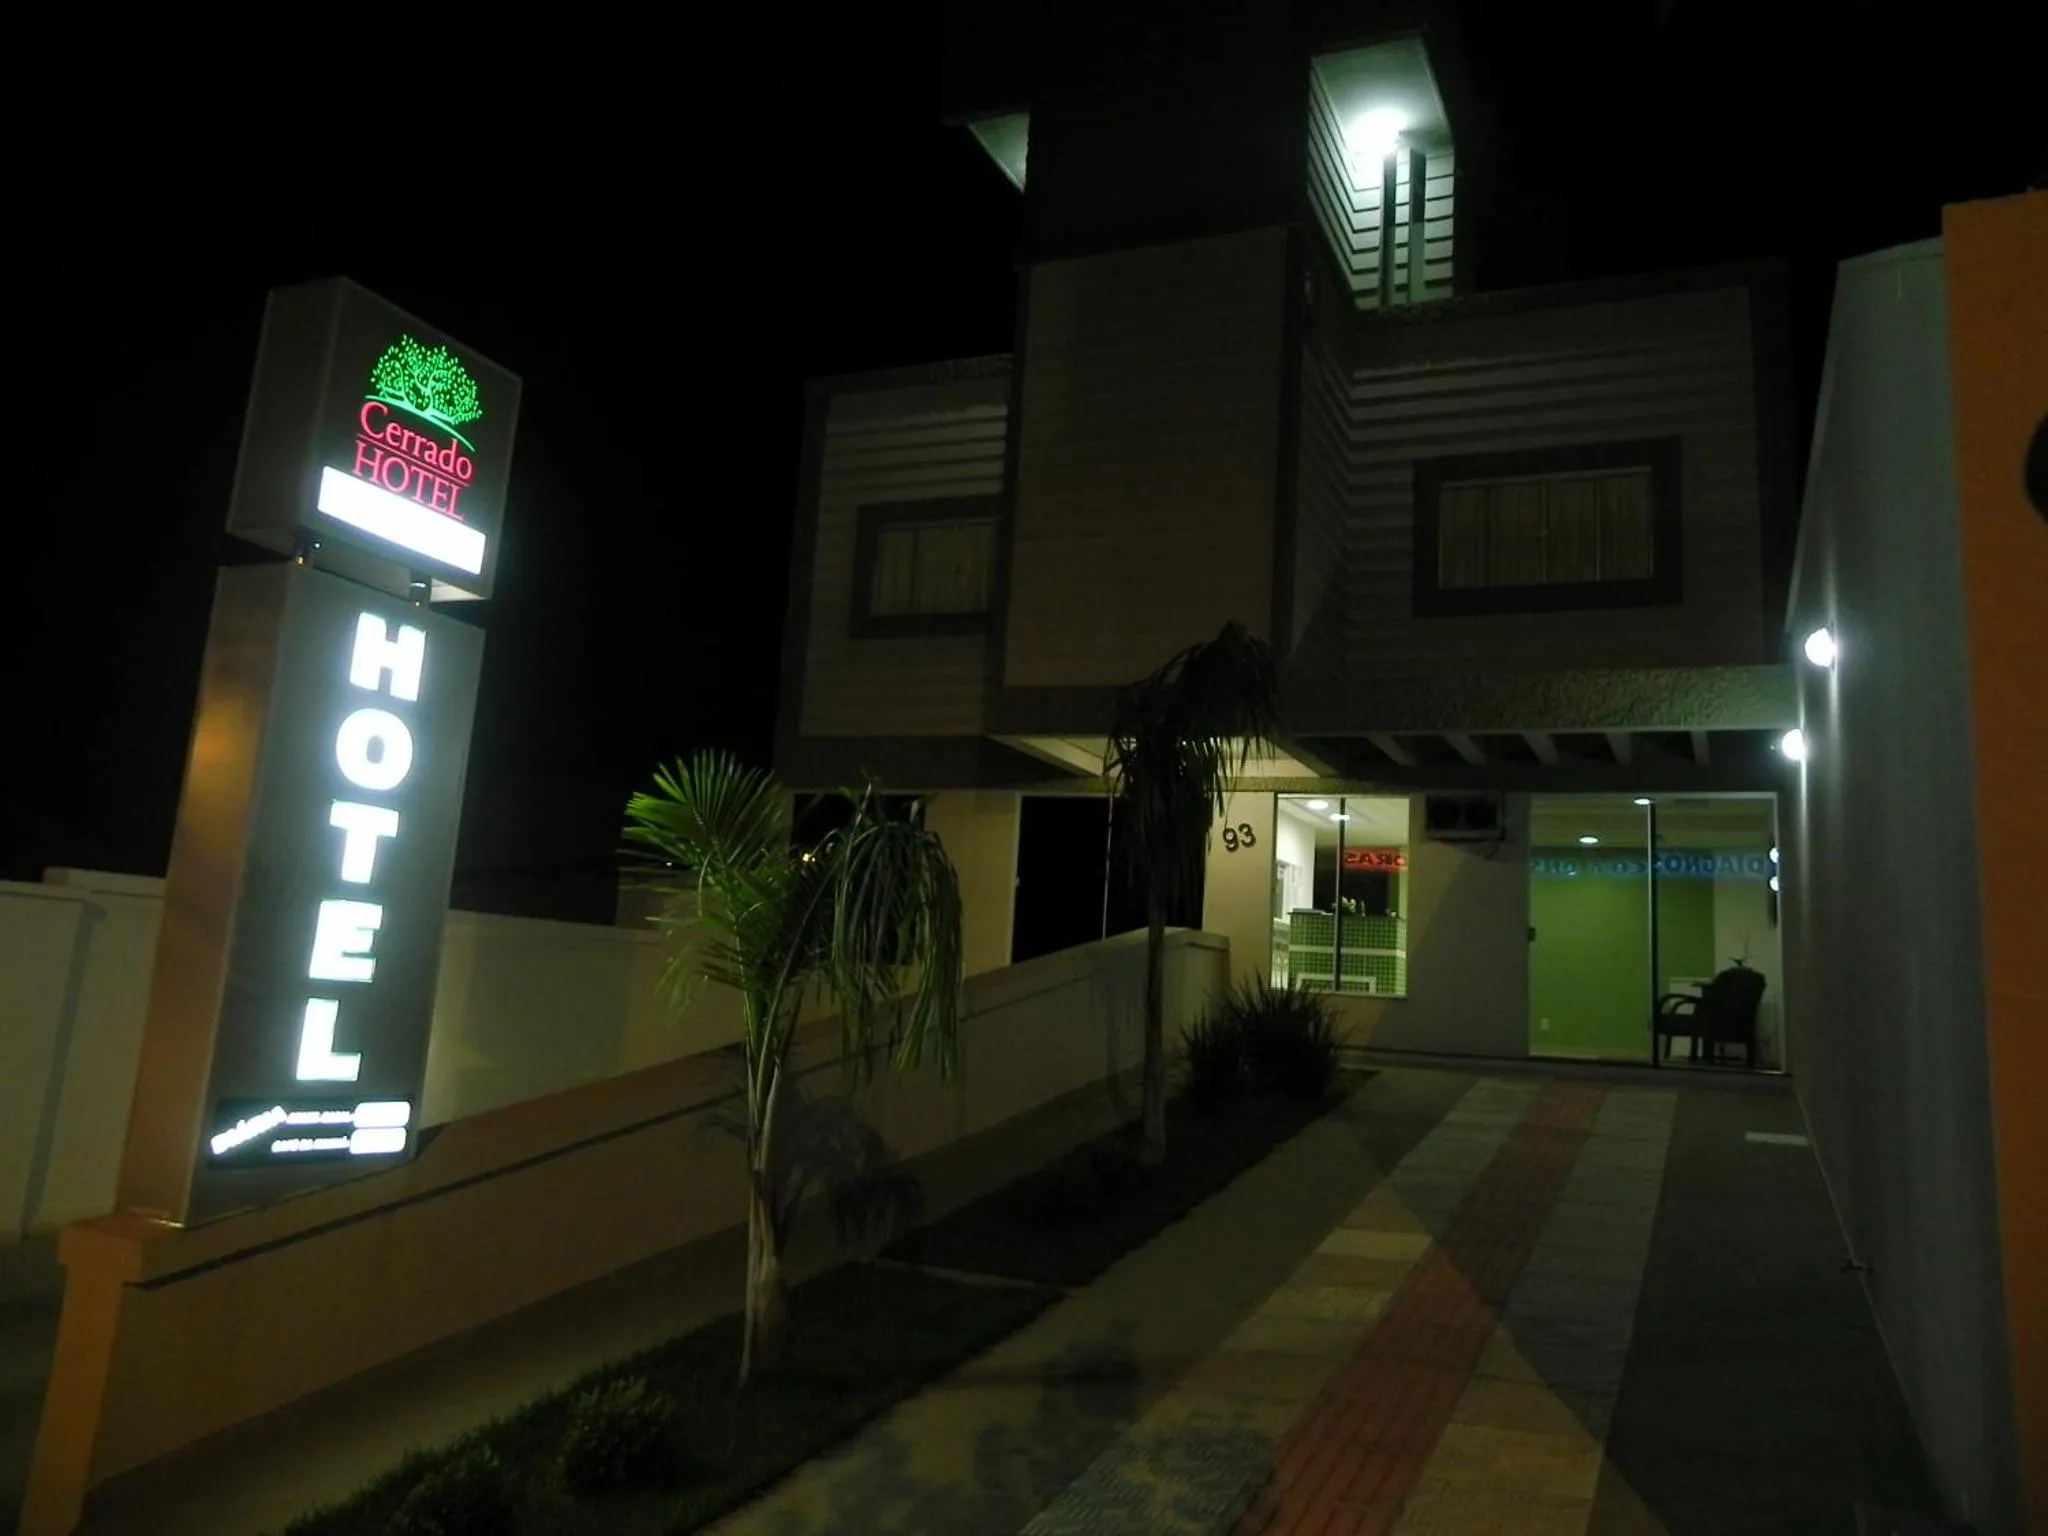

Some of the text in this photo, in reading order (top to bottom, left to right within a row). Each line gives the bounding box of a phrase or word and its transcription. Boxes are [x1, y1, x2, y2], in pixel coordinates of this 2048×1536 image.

[352, 440, 464, 520] HOTEL
[359, 401, 475, 480] Cerrado
[295, 611, 426, 1083] HOTEL
[1222, 822, 1257, 852] 93
